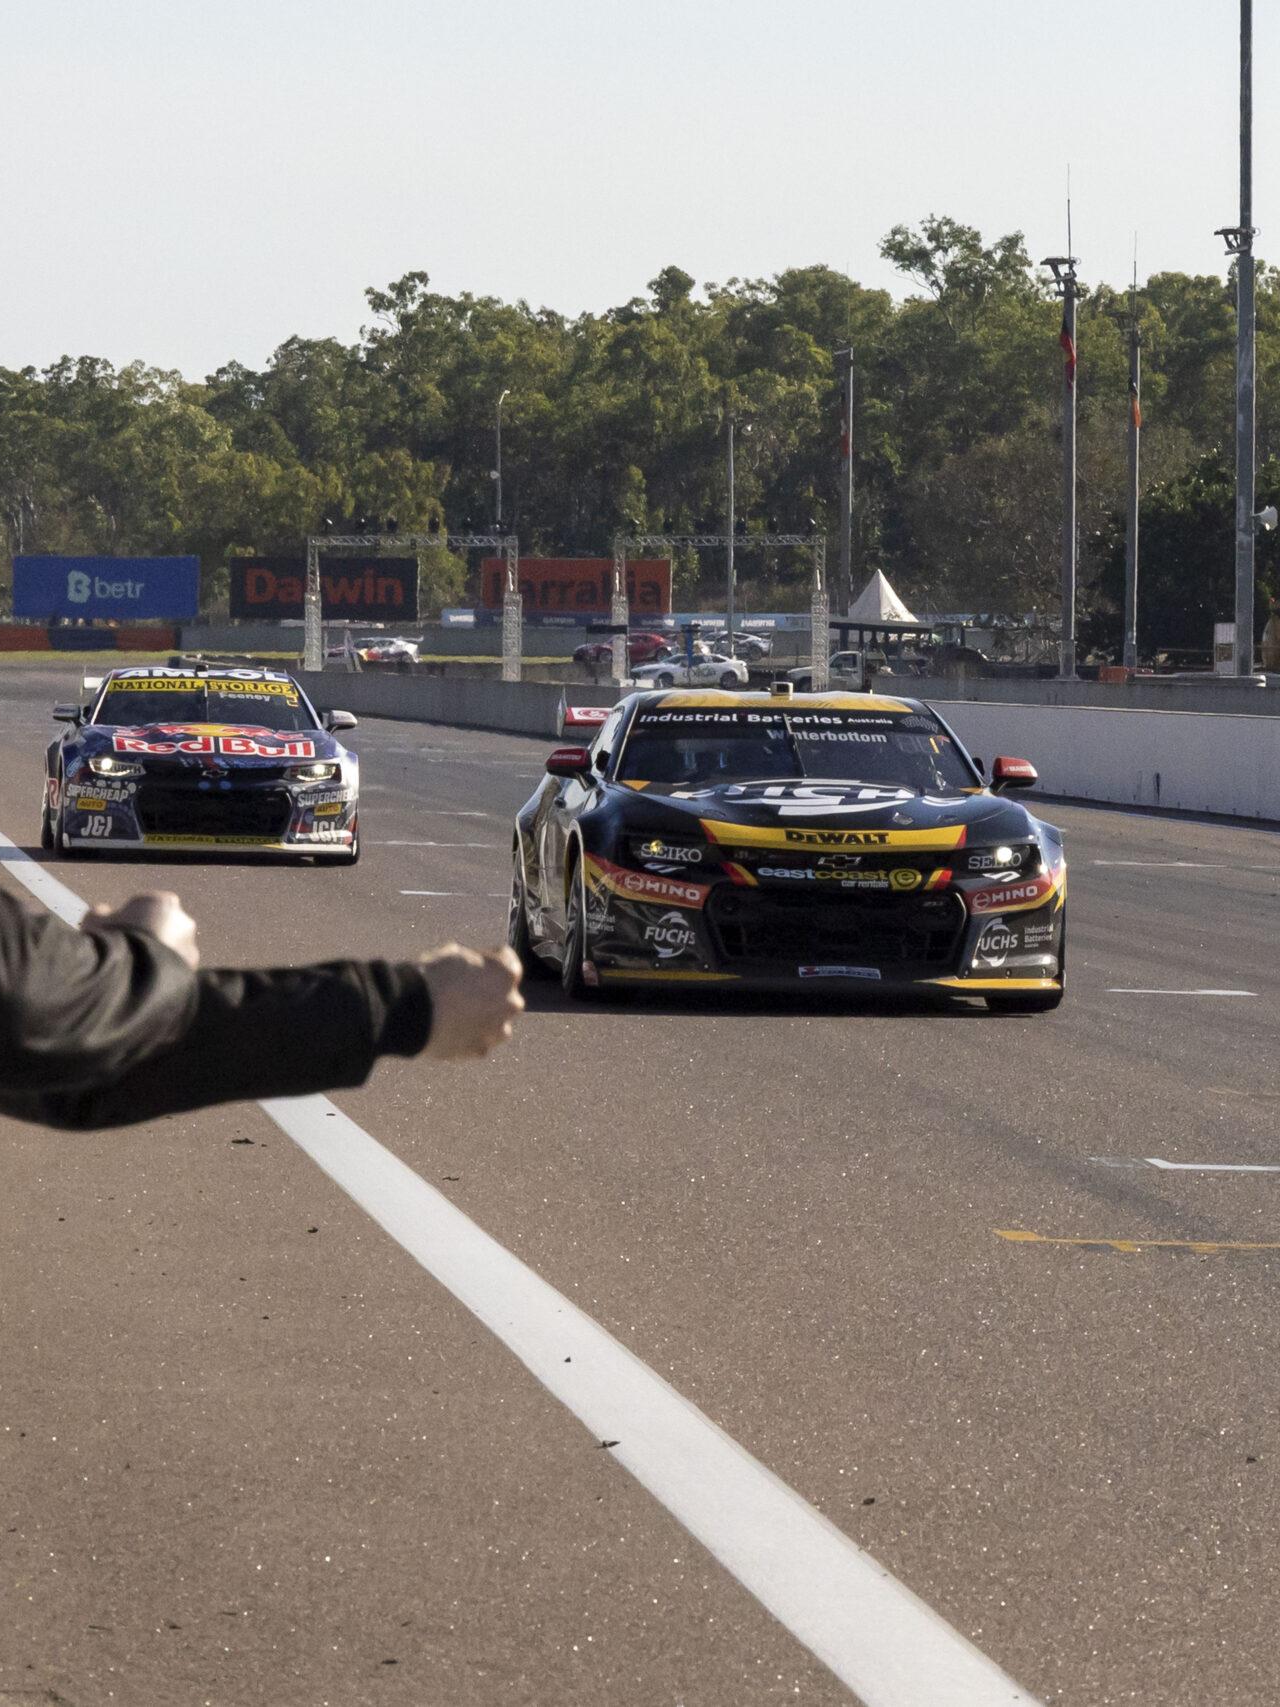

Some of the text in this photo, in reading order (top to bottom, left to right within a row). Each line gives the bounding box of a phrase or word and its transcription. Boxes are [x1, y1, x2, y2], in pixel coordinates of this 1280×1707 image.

[94, 576, 144, 599] betr
[245, 568, 403, 604] Dawin
[111, 680, 293, 694] NATIONAL STORAGE
[639, 713, 738, 724] Industrial
[747, 713, 843, 725] Batteries
[847, 717, 894, 725] Australia
[766, 729, 888, 743] Wnterbottom
[112, 735, 315, 758] Red Bull
[645, 879, 701, 901] HINO
[991, 886, 1038, 902] HINO
[644, 926, 696, 945] FUCHS
